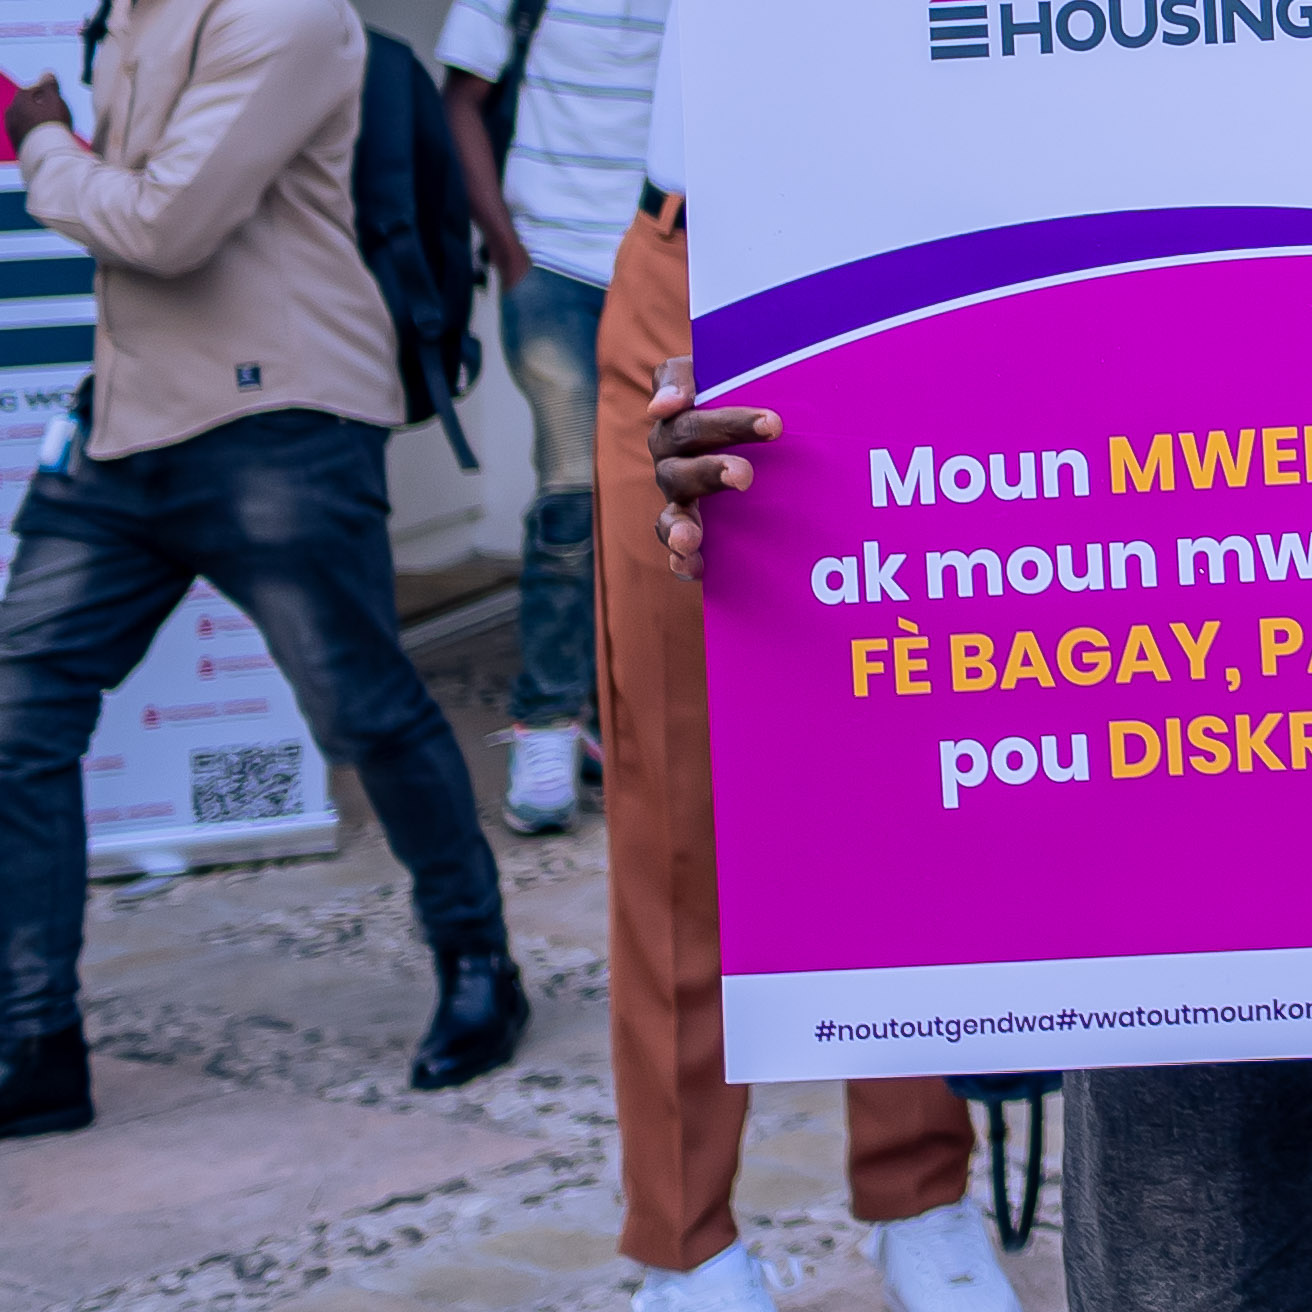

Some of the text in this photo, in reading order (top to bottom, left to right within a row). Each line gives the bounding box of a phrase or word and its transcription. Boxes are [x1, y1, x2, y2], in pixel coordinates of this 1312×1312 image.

[870, 447, 1089, 507] Moun
[812, 541, 909, 604] ak
[926, 541, 1157, 598] moun
[852, 617, 931, 696] FÈ
[950, 621, 1240, 691] BAGAY,
[940, 734, 1089, 808] pou
